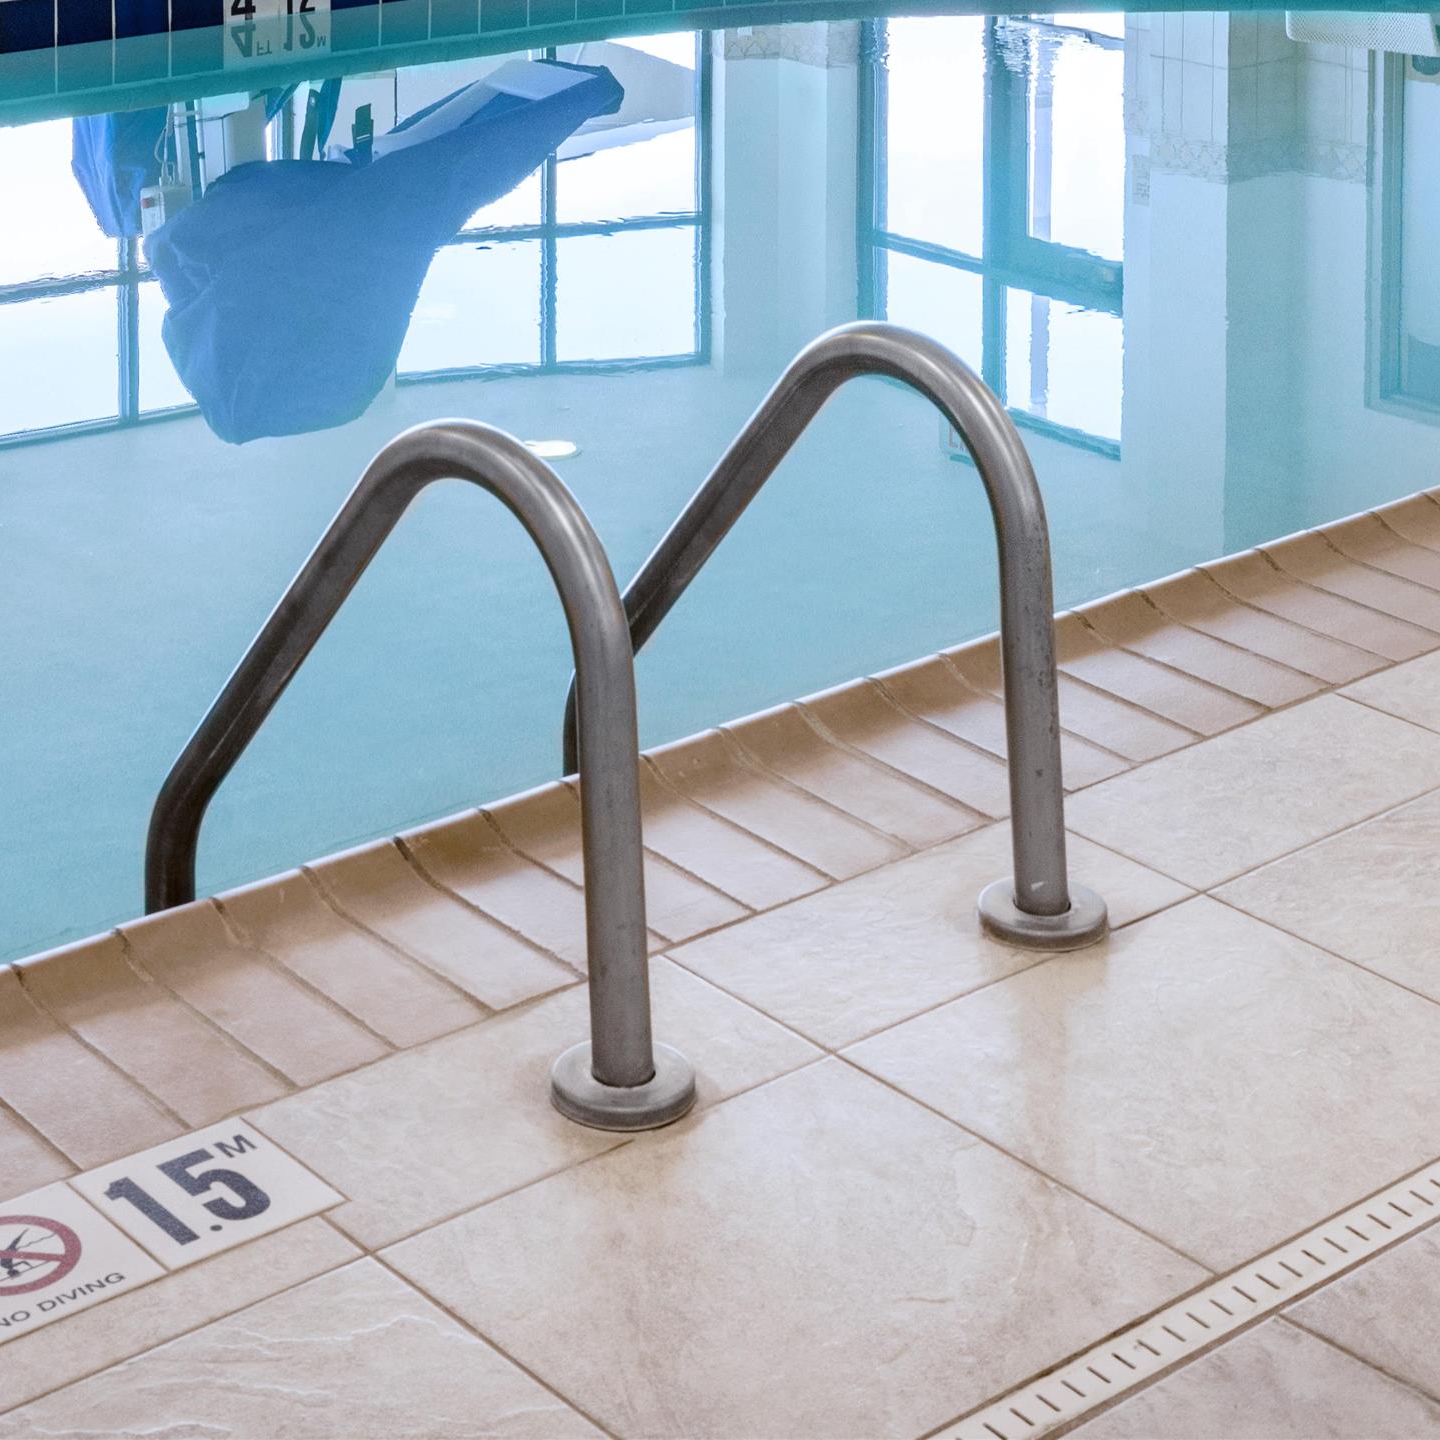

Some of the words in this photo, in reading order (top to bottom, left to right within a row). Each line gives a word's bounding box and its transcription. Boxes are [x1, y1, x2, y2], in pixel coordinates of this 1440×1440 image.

[103, 1148, 272, 1247] 1.5
[216, 1133, 257, 1159] M
[37, 1271, 127, 1316] DIVING
